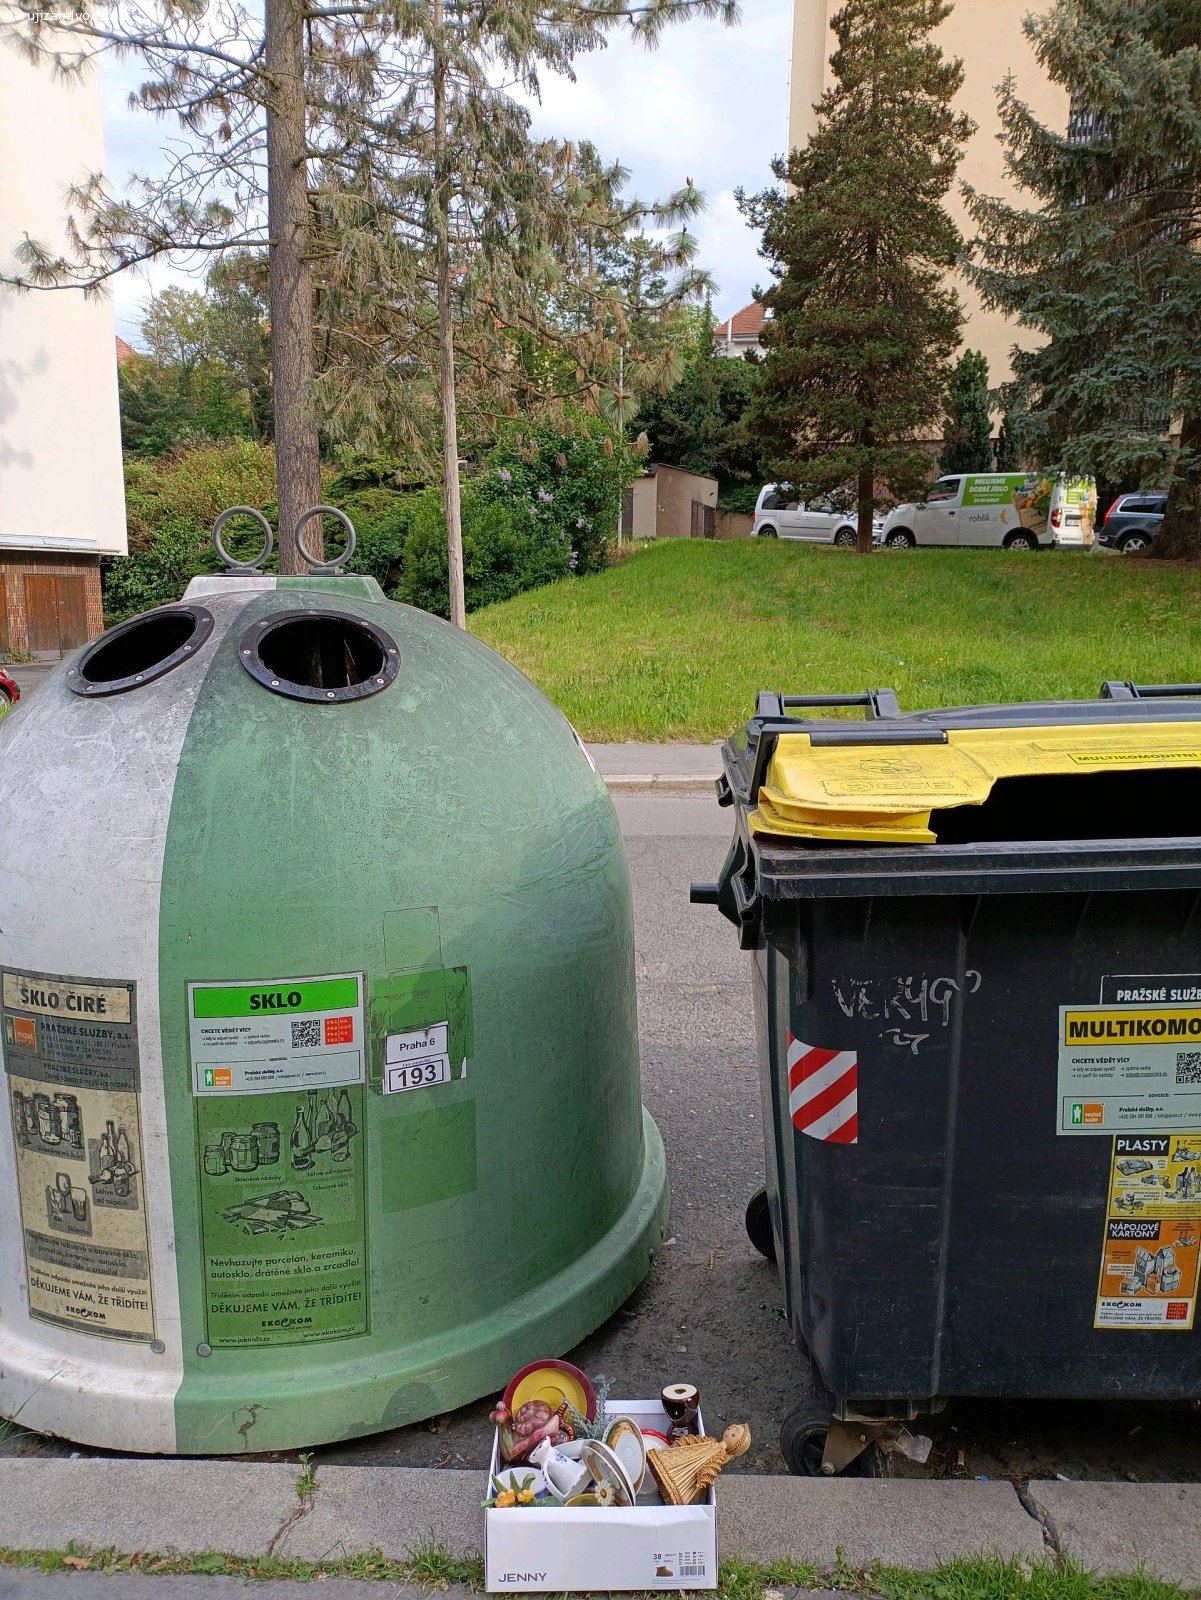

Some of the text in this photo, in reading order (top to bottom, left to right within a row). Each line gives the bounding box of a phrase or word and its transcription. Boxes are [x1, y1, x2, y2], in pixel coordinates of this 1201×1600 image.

[21, 988, 107, 1013] SKLO ČIRÉ
[249, 991, 302, 1010] SKLO
[1116, 987, 1166, 1001] PRAŽSKÉ
[40, 1021, 77, 1035] PRAŽSKÉ
[79, 1025, 115, 1039] SLUŽBY,
[1069, 1018, 1201, 1037] MULTIKOMO
[400, 1040, 427, 1051] Praha
[398, 1065, 436, 1086] 193
[1117, 1139, 1168, 1151] PLASTY
[1109, 1220, 1159, 1232] NÁPOJOVÉ
[1112, 1230, 1156, 1239] KARTONY
[210, 1247, 357, 1268] Nevhazujte porcelán, keramiku,
[211, 1269, 253, 1279] autosklo,
[255, 1267, 291, 1278] drátěné
[293, 1265, 311, 1274] sklo
[323, 1257, 360, 1270] zrcadla!
[31, 1277, 148, 1311] DĚKUJEME VÁM, ŽE TŘÍDÍTE!
[211, 1292, 362, 1313] DĚKUJEME VÁM, ŽE TŘÍDÍTE!
[498, 1572, 548, 1583] JENNY
